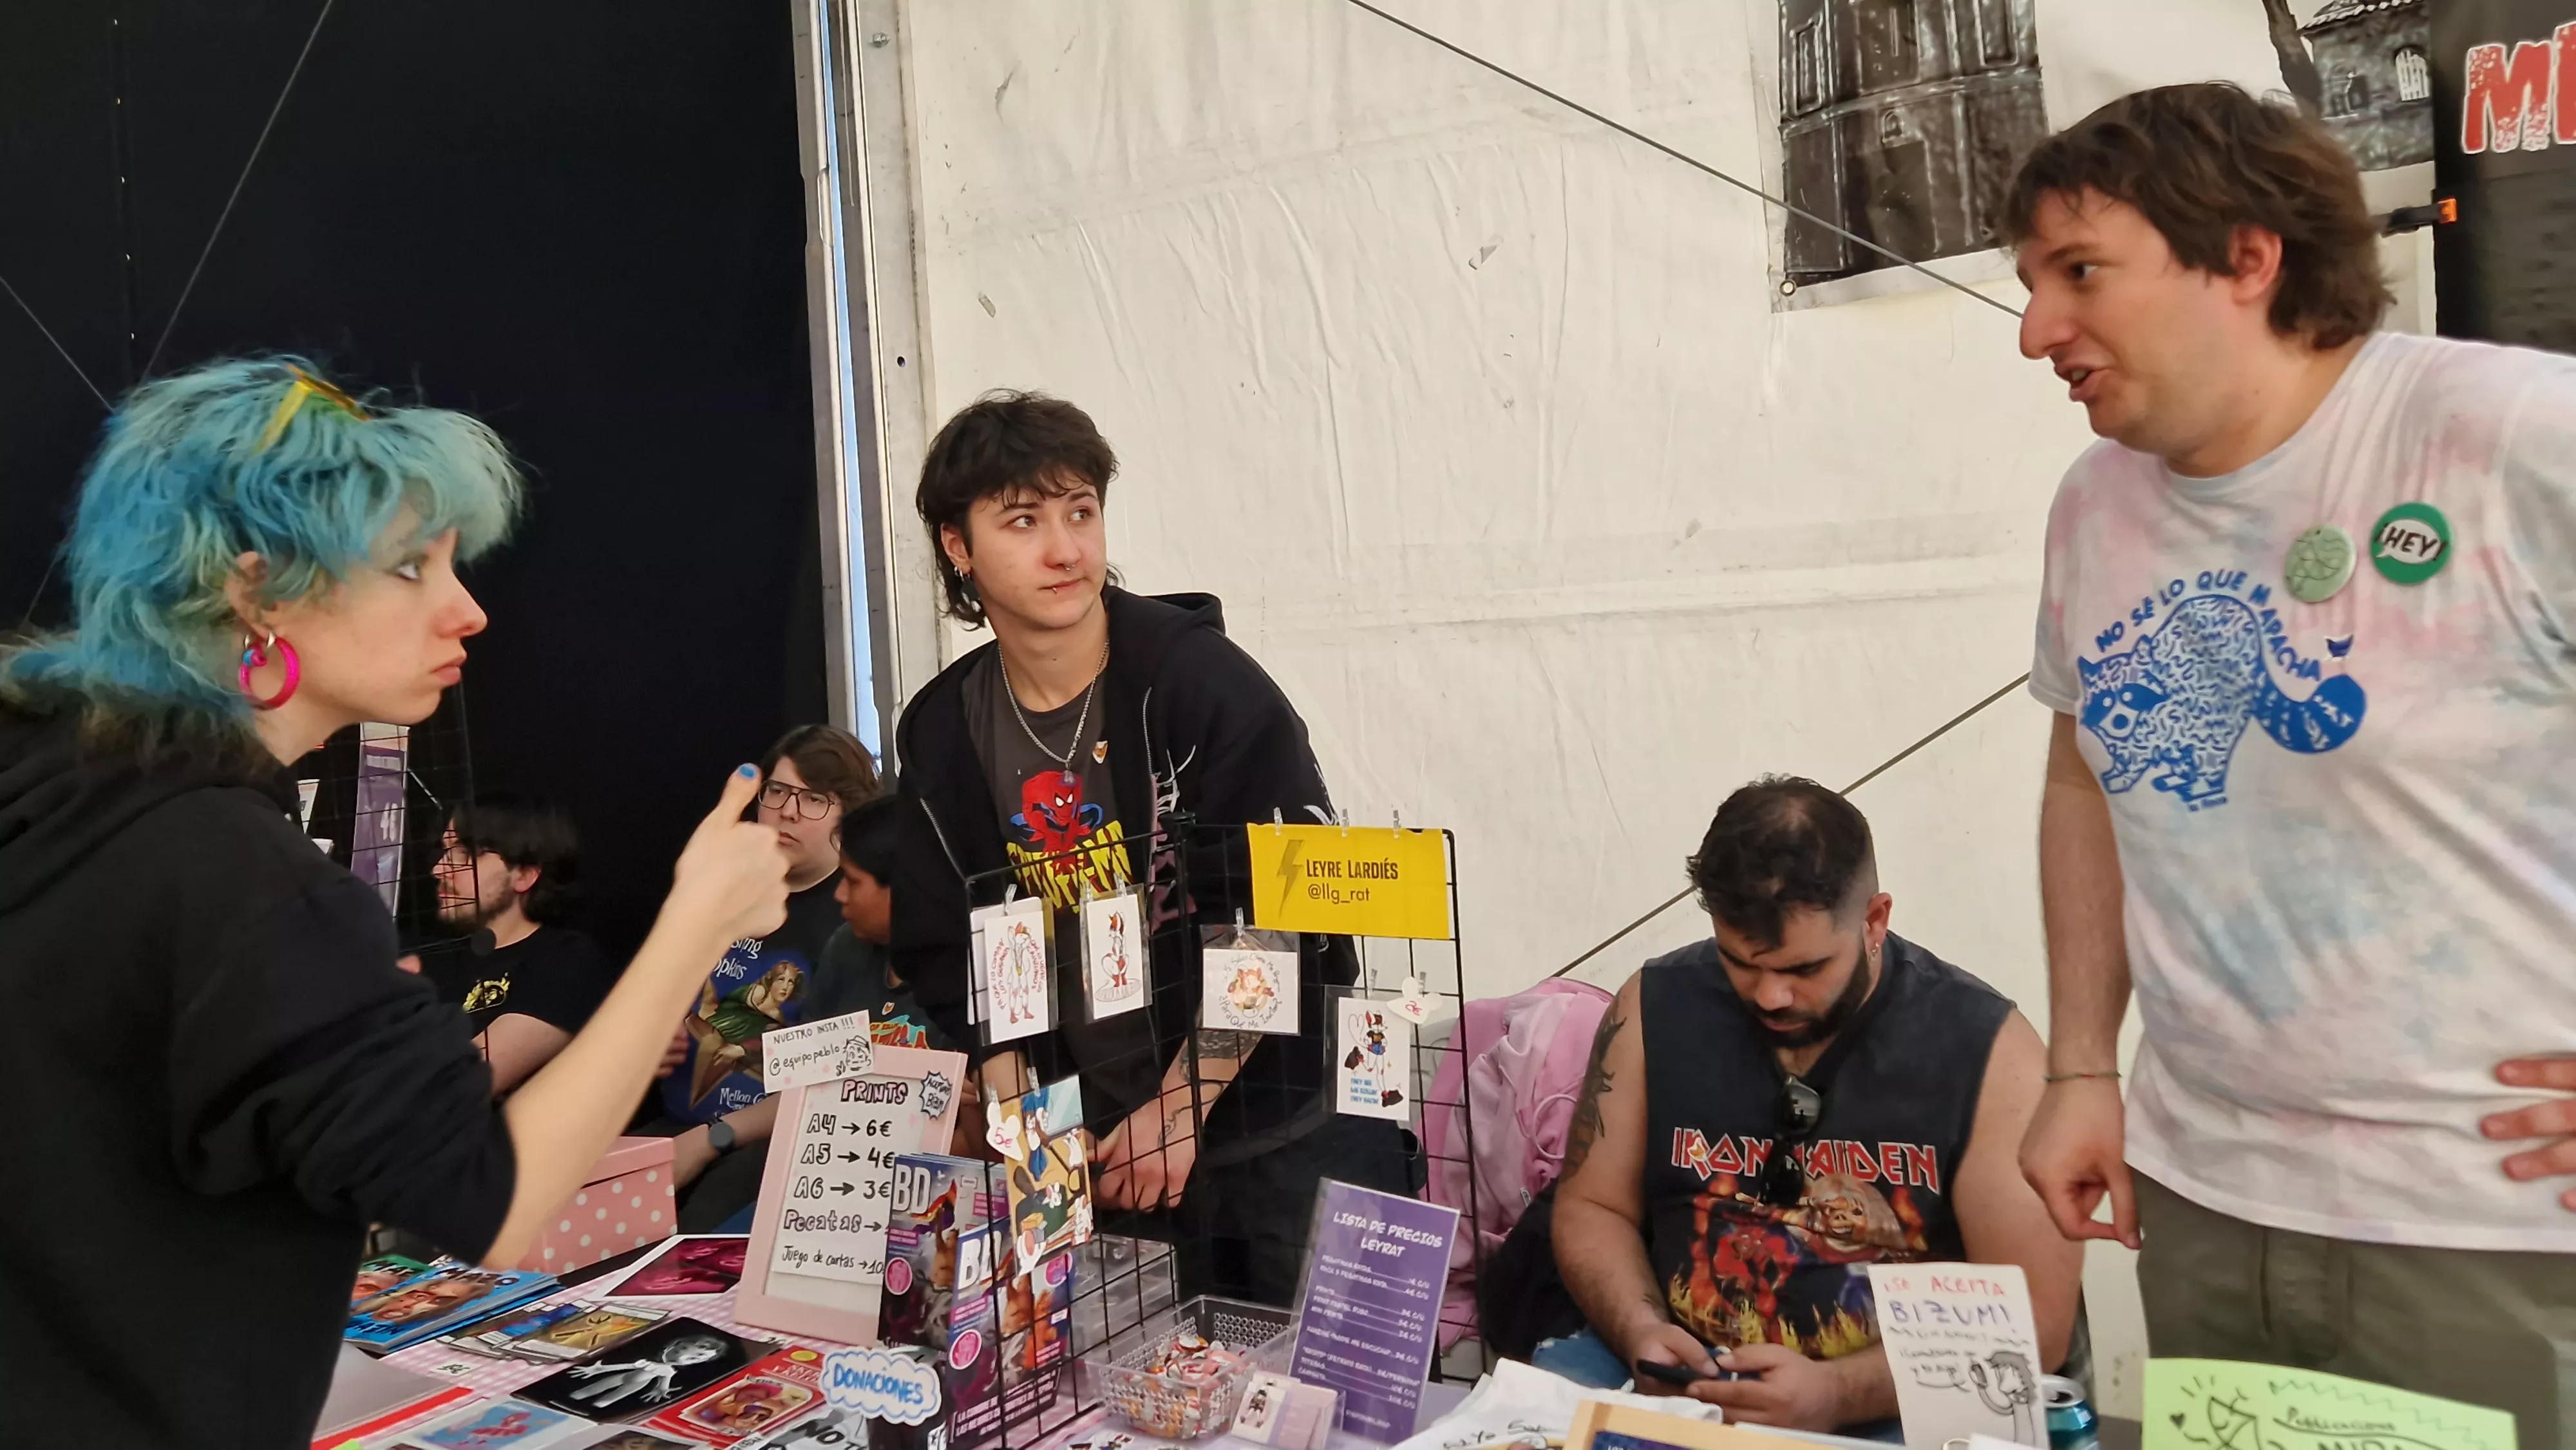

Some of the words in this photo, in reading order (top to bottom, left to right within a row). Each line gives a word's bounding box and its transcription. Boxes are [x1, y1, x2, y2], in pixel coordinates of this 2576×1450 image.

[2095, 621, 2125, 653] NO
[2159, 579, 2186, 607] LO
[2197, 569, 2248, 591] QUE
[1306, 858, 1342, 878] LEYRE
[1347, 857, 1398, 880] LARDIÉS
[1308, 882, 1370, 905] @llg_rat
[772, 1028, 813, 1044] NUESTRO
[817, 1021, 838, 1035] INSTA
[719, 1088, 751, 1108] Mellon
[840, 1079, 908, 1105] PRINTS
[807, 1113, 836, 1135] A4
[866, 1119, 893, 1137] 6€
[800, 1143, 831, 1164] A5
[867, 1147, 895, 1169] 4€
[1672, 1127, 1774, 1181] IRON
[1786, 1138, 1940, 1195] AIDEN
[793, 1176, 824, 1199] A6
[863, 1180, 891, 1200] 3€
[891, 1163, 931, 1215] BD
[1332, 1211, 1367, 1229] LISTA
[1368, 1220, 1386, 1234] DE
[1387, 1225, 1443, 1248] PRECIOS
[782, 1245, 808, 1268] Juego
[813, 1249, 822, 1263] de
[826, 1253, 855, 1268] cartas
[1360, 1237, 1405, 1257] LEYRAT
[834, 1363, 923, 1404] DONACIONES
